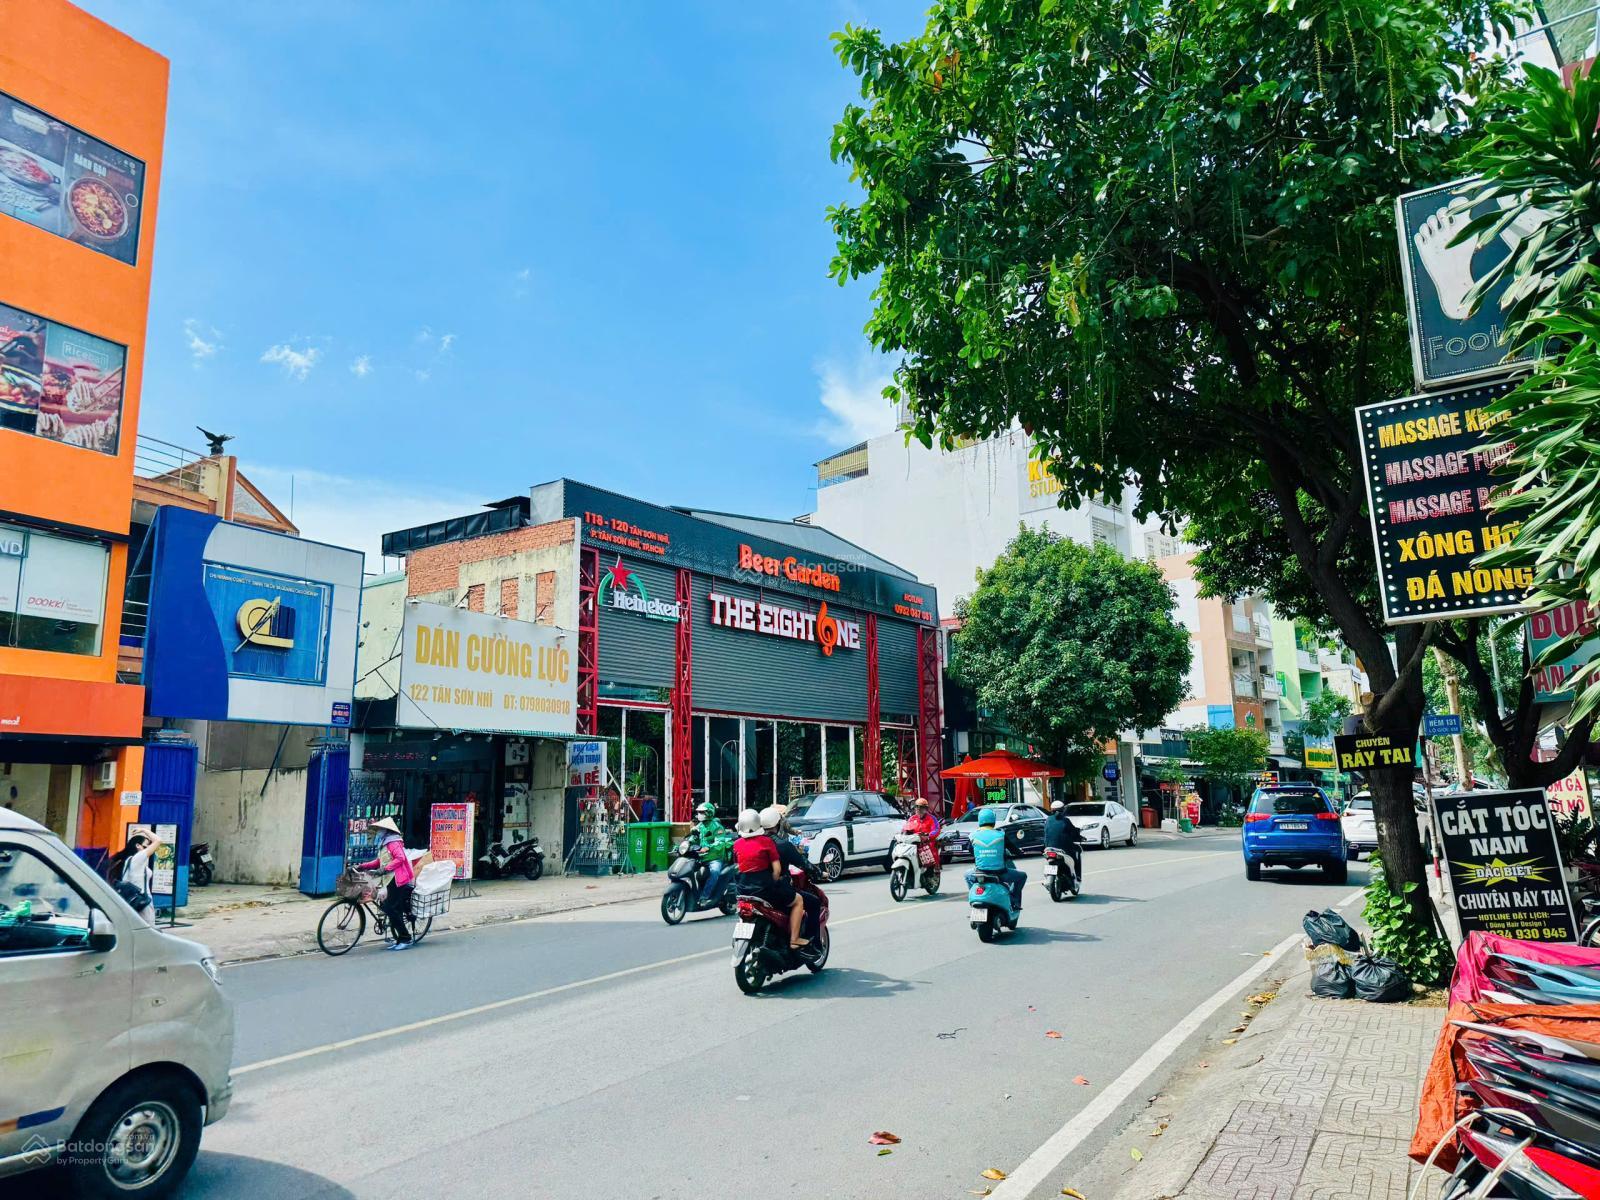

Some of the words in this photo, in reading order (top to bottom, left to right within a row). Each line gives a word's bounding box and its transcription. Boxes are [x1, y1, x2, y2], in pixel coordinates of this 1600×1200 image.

[1378, 412, 1462, 448] MASSAGE
[1385, 450, 1469, 486] MASSAGE
[1389, 490, 1474, 524] MASSAGE
[584, 511, 604, 526] 118
[610, 518, 629, 533] 120
[629, 525, 643, 537] TÂN
[1397, 531, 1475, 562] XÔNG
[739, 544, 780, 576] Beer
[783, 556, 840, 592] Garden
[1406, 569, 1446, 601] ĐÁ
[27, 597, 65, 609] DOOKKI
[613, 589, 680, 618] Heineken
[708, 592, 756, 631] THE
[757, 602, 817, 642] EIGHT
[415, 622, 460, 669] DÁN
[466, 632, 533, 679] CƯỜNG
[538, 644, 570, 688] LỰC
[410, 683, 429, 701] 122
[431, 683, 452, 704] TÂN
[454, 688, 474, 706] SƠN
[1446, 718, 1457, 726] 131
[1355, 736, 1390, 749] CHUYÊN
[1341, 750, 1376, 769] RÁY
[1380, 748, 1411, 765] TAI
[1441, 799, 1489, 836] CẮT
[1494, 800, 1548, 832] TÓC
[1470, 835, 1529, 857] NAM
[1475, 862, 1503, 880] ĐẶC
[1503, 865, 1534, 879] BIỆT
[1458, 888, 1512, 910] CHUYÊN
[1512, 887, 1538, 908] RÁY
[1541, 889, 1565, 906] TAI
[1479, 913, 1511, 921] HOTLINE
[1520, 918, 1542, 928] Design
[1516, 929, 1540, 940] 930
[1543, 927, 1567, 939] 945
